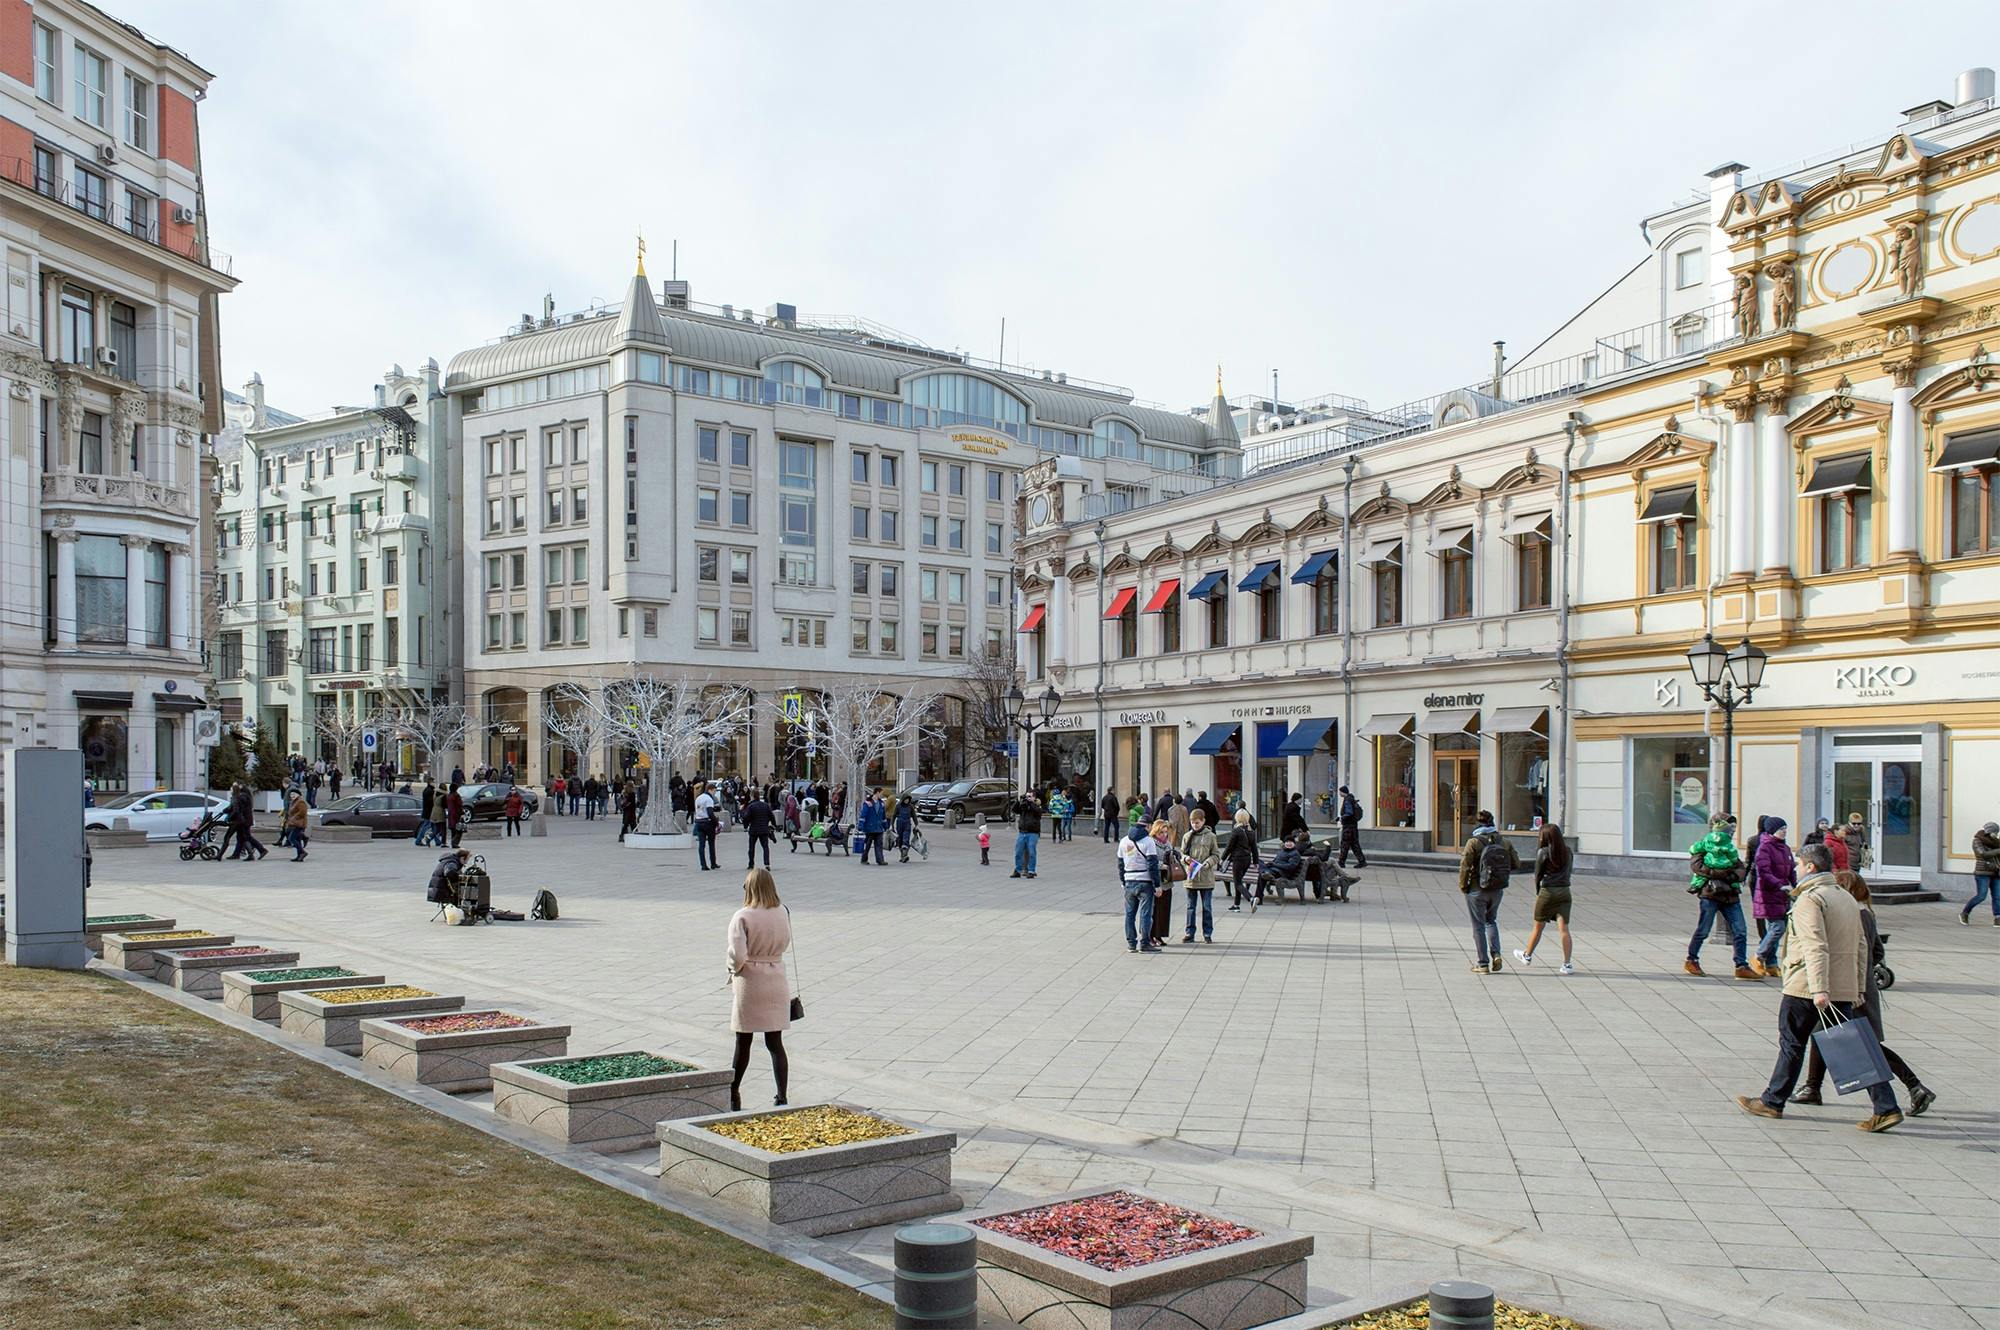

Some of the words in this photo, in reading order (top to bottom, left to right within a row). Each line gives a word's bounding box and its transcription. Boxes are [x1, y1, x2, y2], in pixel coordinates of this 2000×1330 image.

[1835, 664, 1917, 689] KIKO
[1424, 693, 1455, 708] elena
[1231, 707, 1264, 718] TOMMY
[1275, 704, 1312, 716] HILFIGER
[1049, 717, 1073, 728] OMEGA
[1127, 712, 1155, 724] OMEGA
[499, 723, 520, 734] Cartier
